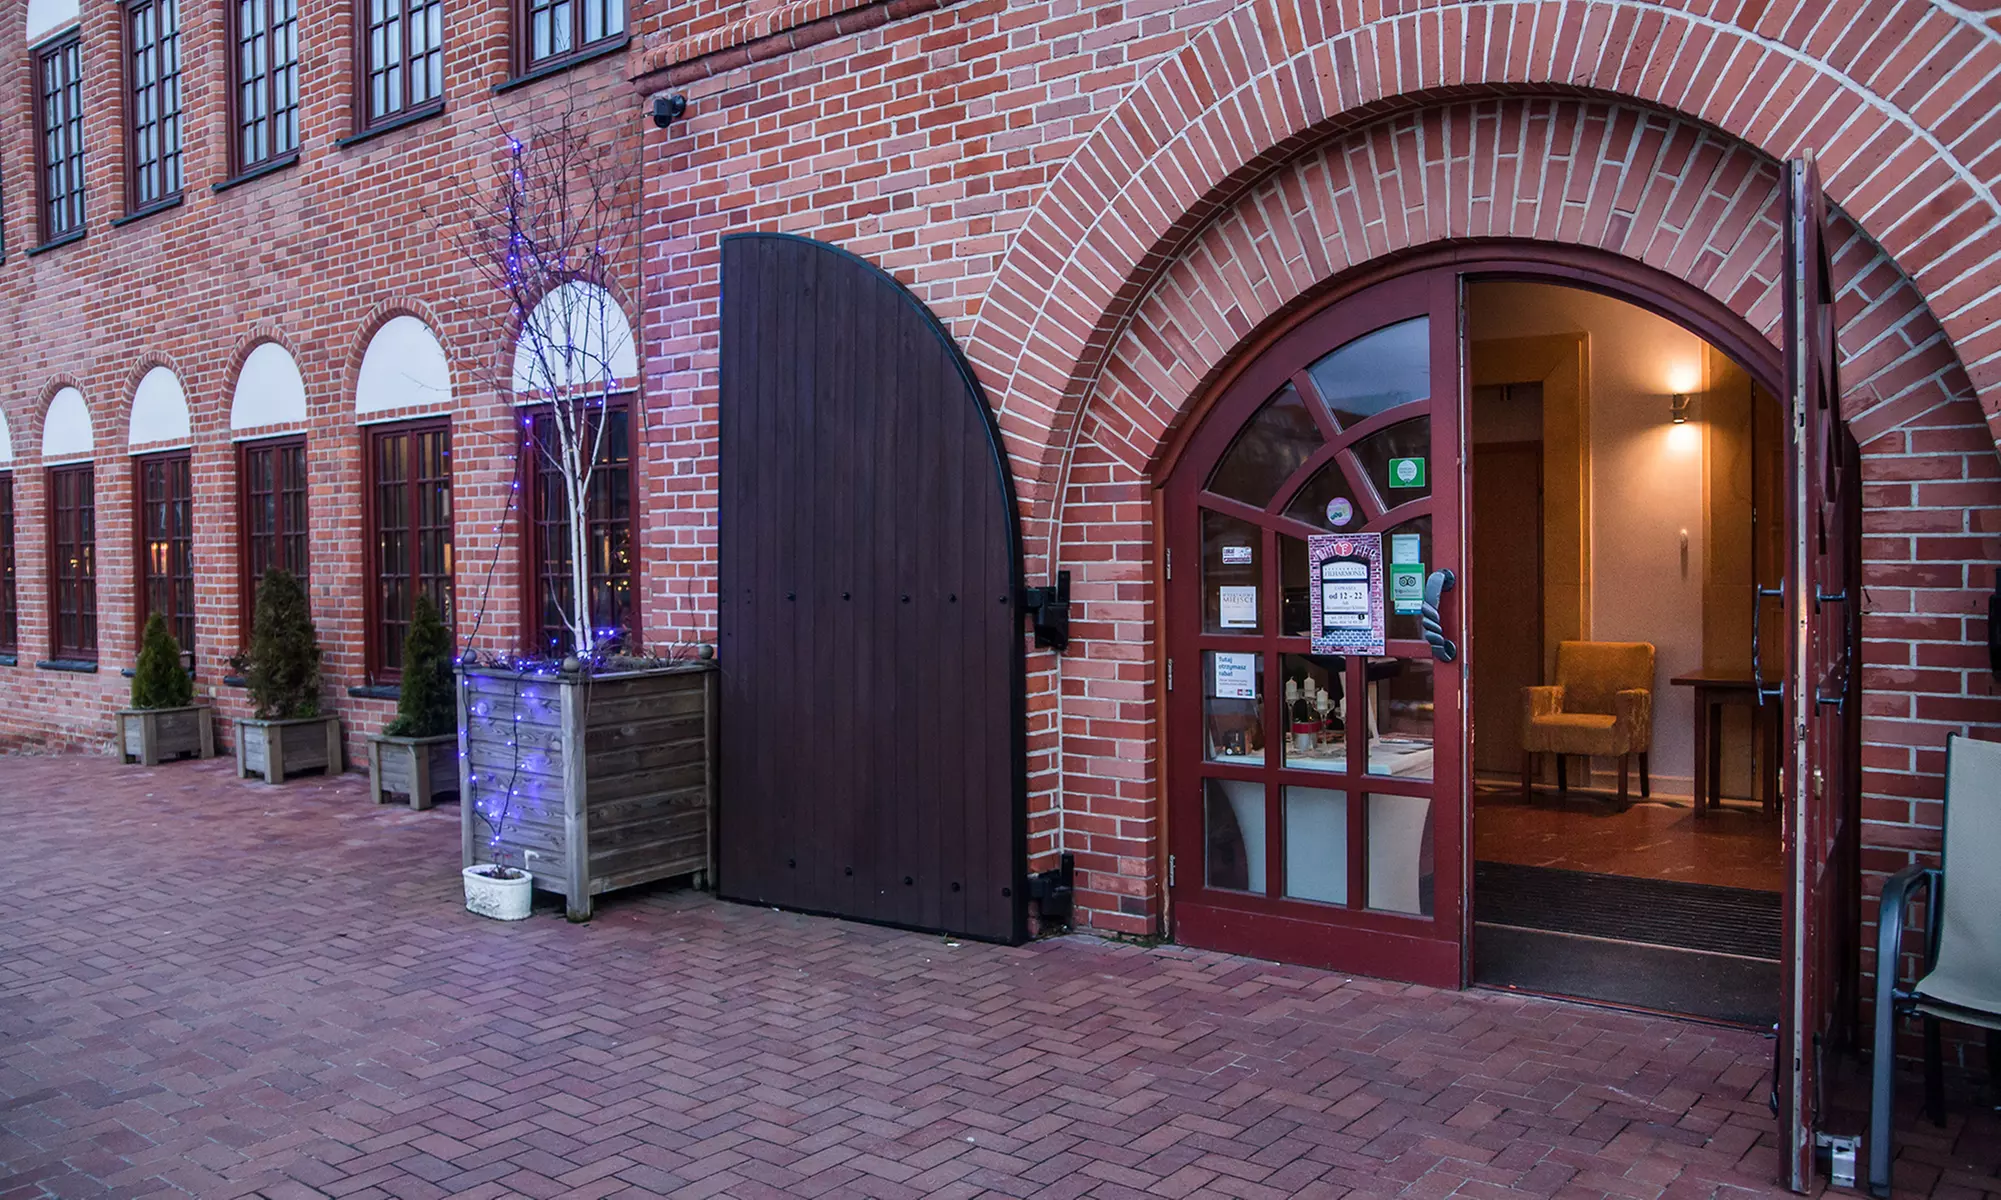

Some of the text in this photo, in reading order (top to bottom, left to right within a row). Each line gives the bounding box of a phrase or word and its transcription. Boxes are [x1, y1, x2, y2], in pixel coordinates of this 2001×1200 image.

[1223, 596, 1253, 604] MIEJSCE
[1328, 592, 1338, 600] od
[1340, 592, 1348, 600] 12
[1354, 592, 1363, 600] 22
